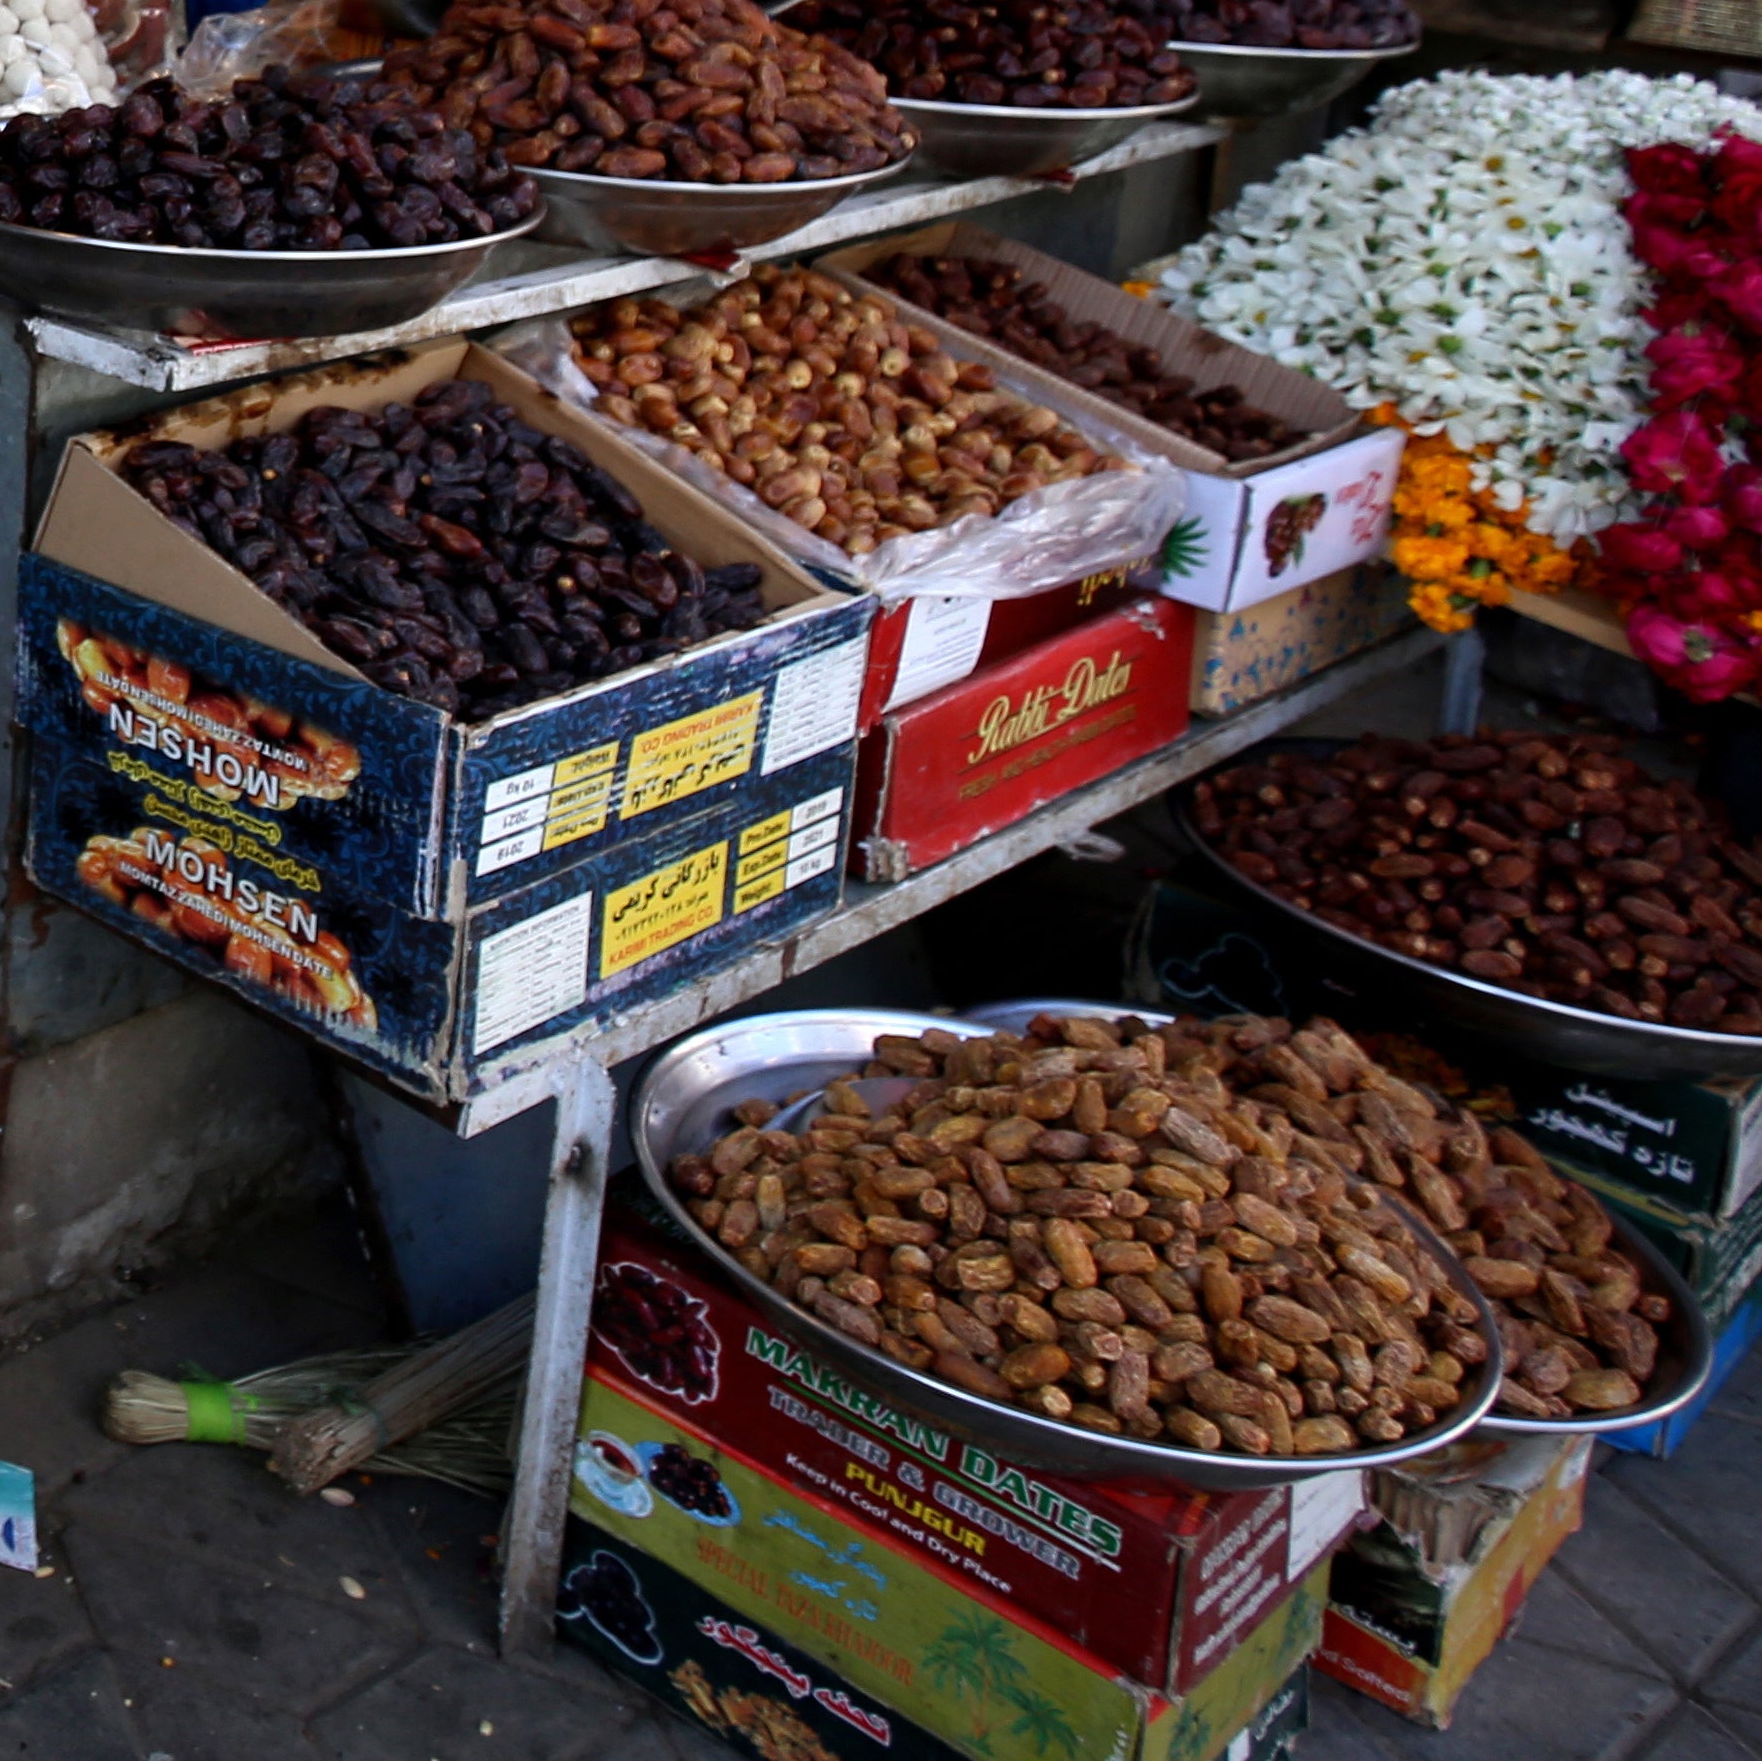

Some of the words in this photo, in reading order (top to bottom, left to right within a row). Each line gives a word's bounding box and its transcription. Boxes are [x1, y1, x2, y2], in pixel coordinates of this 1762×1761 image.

[109, 702, 279, 809] MOHSEN
[145, 832, 319, 943] MOHSEN
[648, 913, 696, 948] TRADING
[744, 1325, 953, 1460] MAKRAN
[959, 1444, 1125, 1557] DATES
[767, 1384, 892, 1472] TRADER
[897, 1460, 925, 1493] &
[933, 1479, 1083, 1581] GROWER
[785, 1452, 827, 1485] Keep
[829, 1474, 847, 1496] in
[849, 1486, 887, 1525] Cool
[890, 1509, 927, 1544] and
[928, 1530, 962, 1568] Dry
[963, 1549, 1013, 1592] Place
[844, 1460, 988, 1558] PUNJGUR
[694, 1535, 769, 1605] SPECIAL
